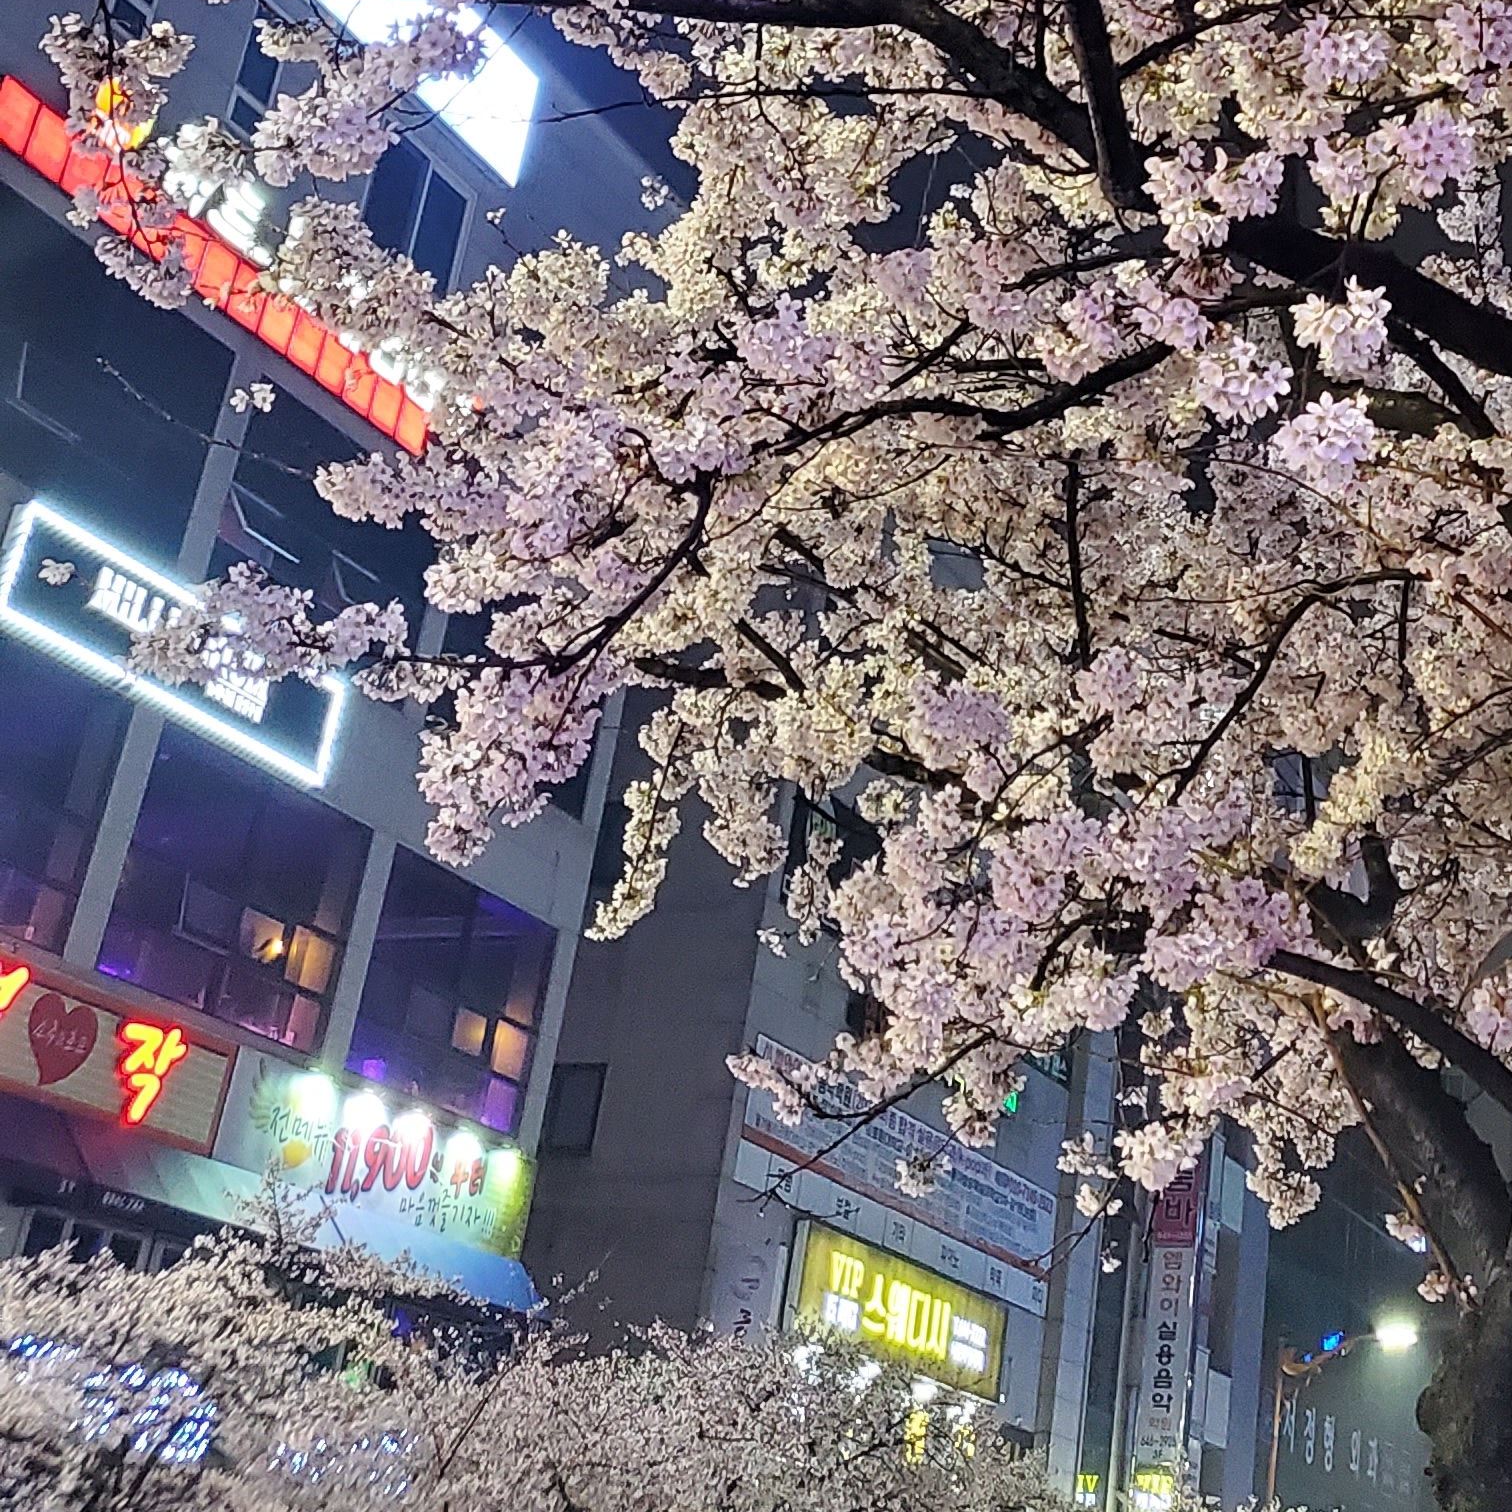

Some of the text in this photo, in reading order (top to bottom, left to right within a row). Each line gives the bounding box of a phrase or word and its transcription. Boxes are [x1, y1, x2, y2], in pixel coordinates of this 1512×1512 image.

[120, 1020, 188, 1126] 작
[829, 1250, 865, 1299] VIP
[861, 1273, 952, 1361] 스웨디시
